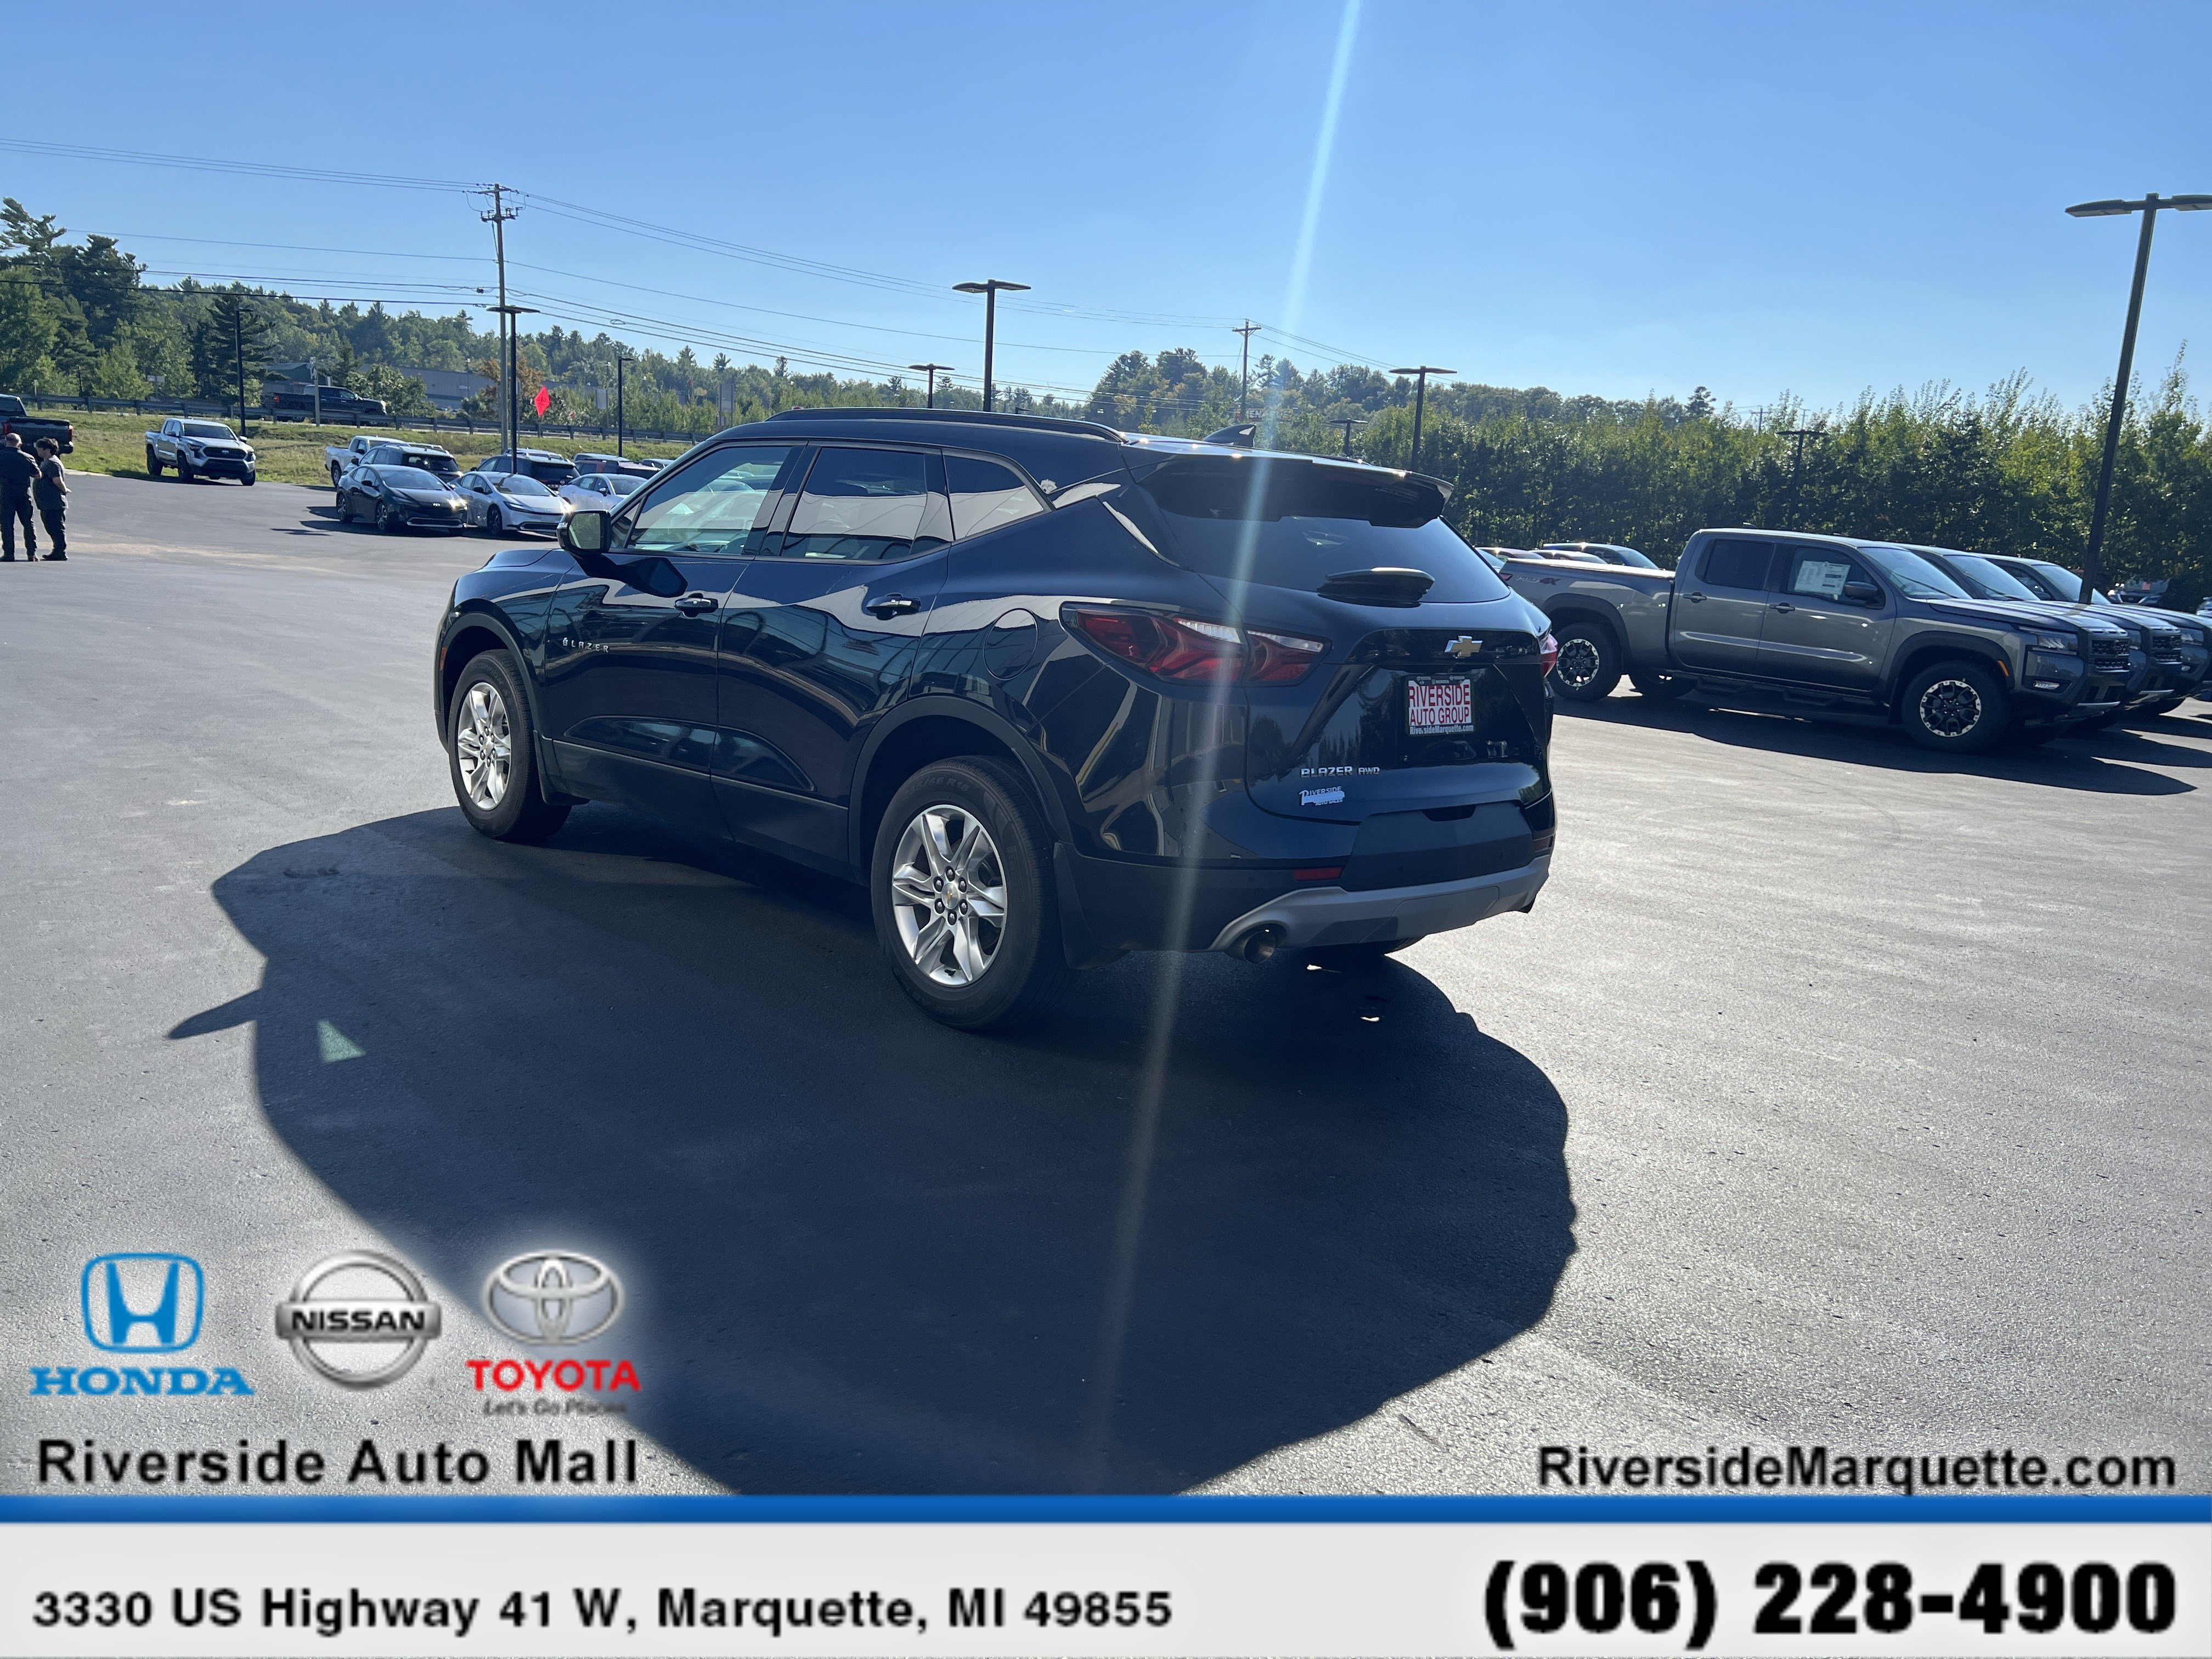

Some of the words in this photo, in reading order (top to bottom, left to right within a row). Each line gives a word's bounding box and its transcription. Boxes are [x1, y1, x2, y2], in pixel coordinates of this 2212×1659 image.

[562, 637, 609, 653] BLAZER
[1409, 685, 1470, 707] RIVERSIDE
[1410, 708, 1435, 725] AUTO
[1438, 707, 1469, 724] GROUP
[1410, 725, 1474, 735] RivesideMarquette.com
[1300, 766, 1353, 778] BLAZER
[1358, 767, 1380, 775] AWD
